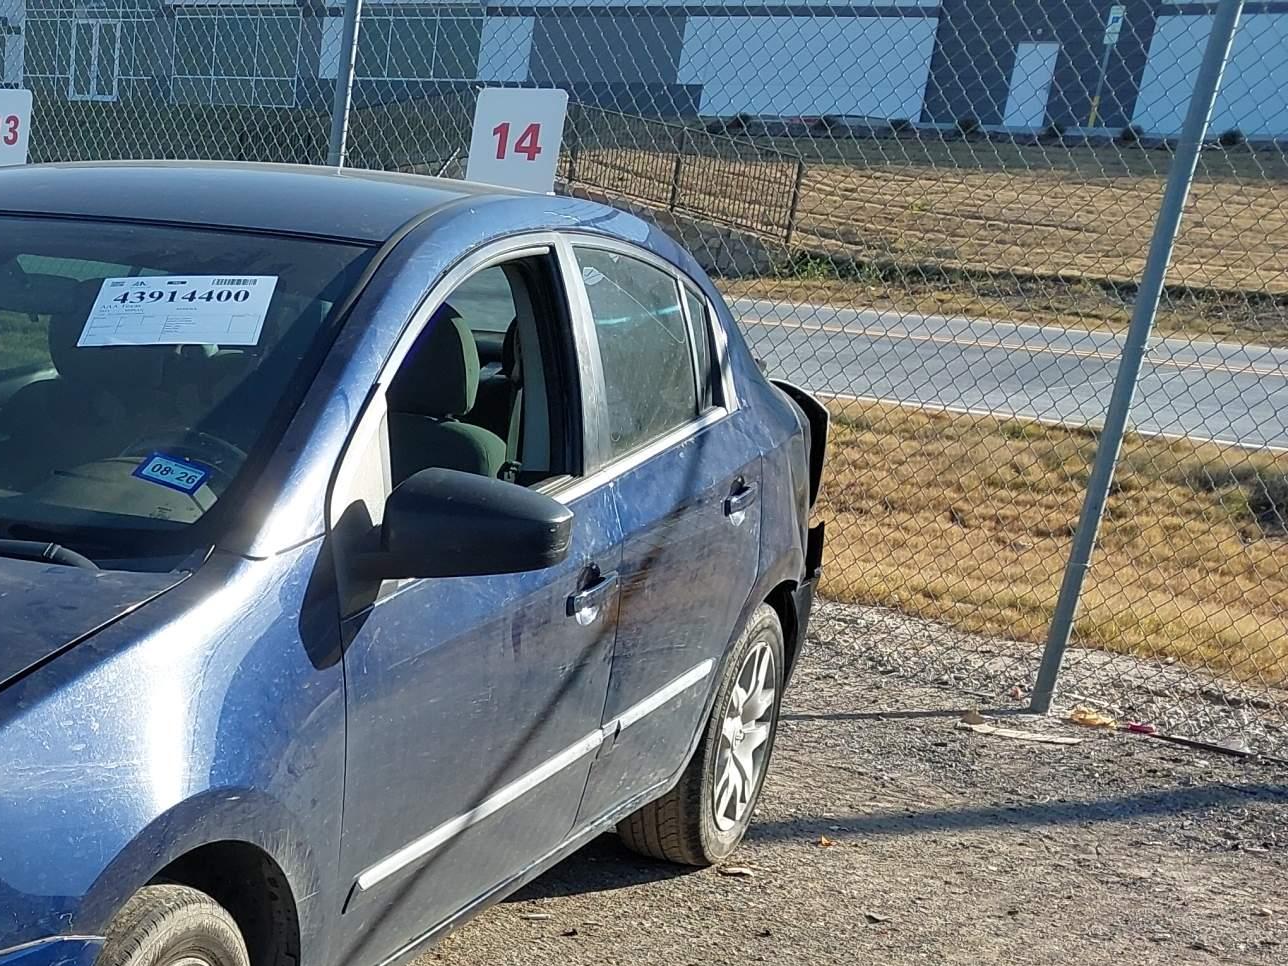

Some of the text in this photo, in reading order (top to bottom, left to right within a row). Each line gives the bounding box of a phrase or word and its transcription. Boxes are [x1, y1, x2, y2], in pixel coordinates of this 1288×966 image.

[492, 122, 542, 161] 14
[112, 289, 250, 304] 43914400
[151, 463, 198, 485] 08 26
